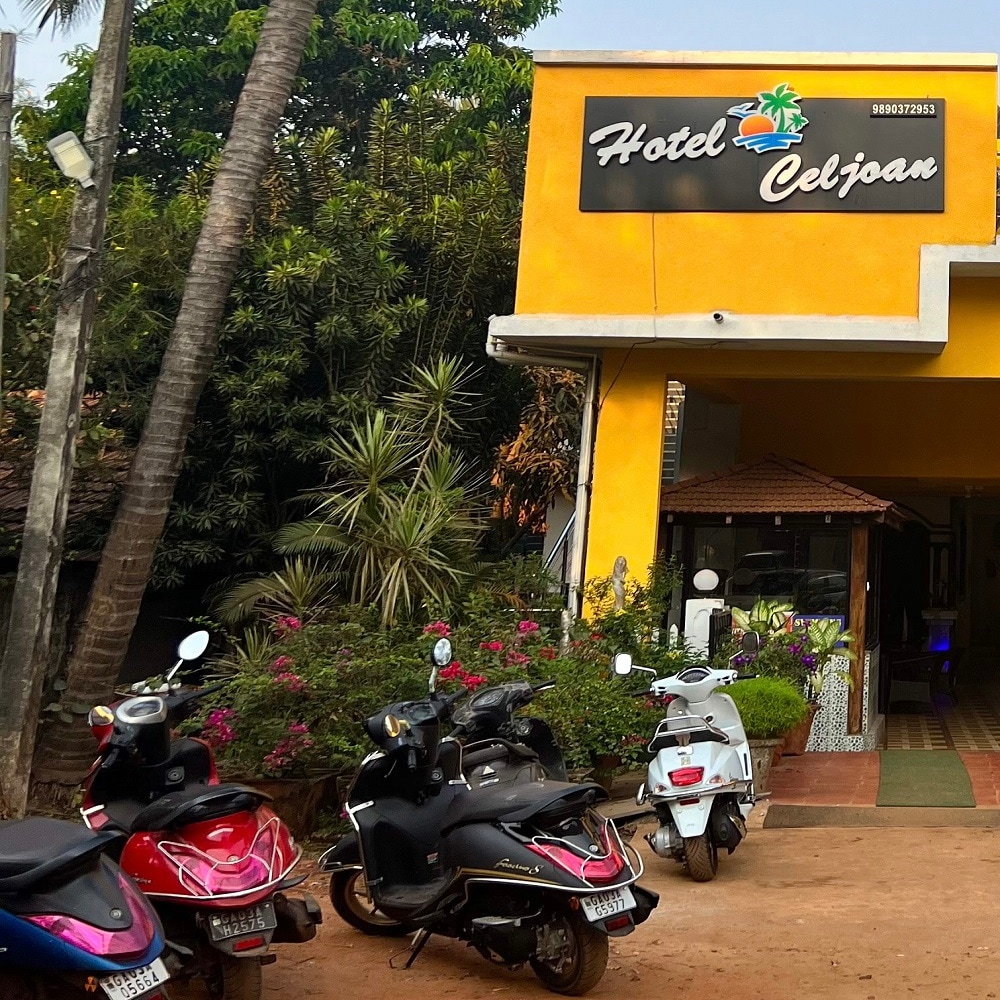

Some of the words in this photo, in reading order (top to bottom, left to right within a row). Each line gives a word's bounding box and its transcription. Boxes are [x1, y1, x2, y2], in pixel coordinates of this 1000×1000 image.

[871, 103, 936, 116] 9890372953
[588, 117, 728, 168] Hotel
[758, 151, 939, 203] Celjoan
[595, 898, 626, 917] G5977
[223, 917, 266, 936] H2575
